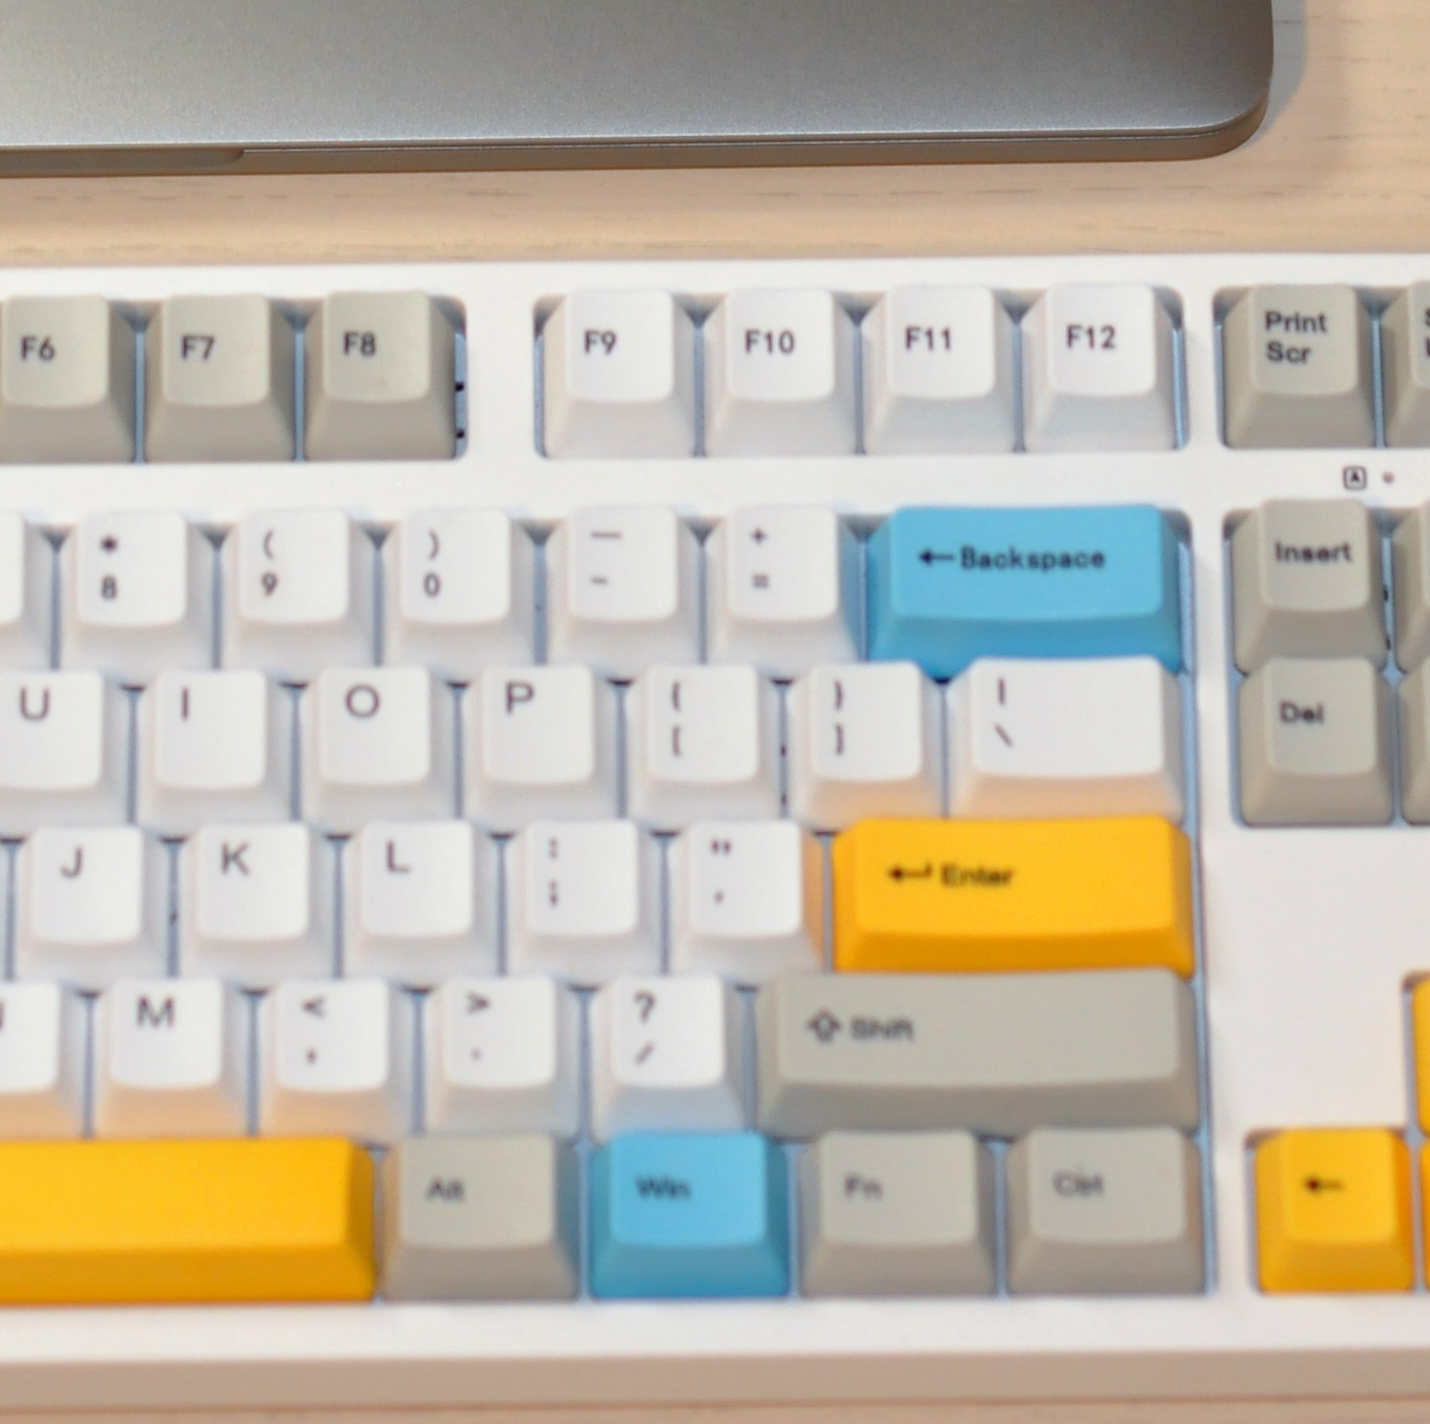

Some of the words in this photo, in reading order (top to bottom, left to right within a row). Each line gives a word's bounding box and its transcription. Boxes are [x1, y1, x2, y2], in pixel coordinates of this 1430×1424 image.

[1263, 309, 1327, 333] Print
[20, 335, 56, 362] F6
[180, 333, 216, 360] F7
[342, 330, 377, 357] F8
[583, 329, 618, 355] F9
[743, 328, 796, 355] F10
[904, 325, 951, 351] F11
[1065, 323, 1116, 351] F12
[1265, 339, 1311, 364] Scr
[959, 545, 1106, 573] Backspace
[1274, 541, 1351, 564] Insert
[100, 575, 118, 601] 8
[260, 571, 279, 597] 9
[422, 571, 442, 599] 0
[18, 687, 51, 723] U
[343, 683, 381, 720] O
[504, 680, 535, 715] P
[1279, 701, 1324, 725] Del
[60, 846, 84, 880] J
[220, 843, 249, 875] K
[385, 840, 409, 874] L
[939, 863, 1014, 888] Enter
[136, 995, 175, 1028] M
[633, 990, 657, 1023] ?
[849, 1016, 915, 1041] Shift
[426, 1178, 465, 1201] Alt
[635, 1176, 691, 1200] Win
[843, 1174, 883, 1198] Fn
[1052, 1171, 1104, 1198] Ctrl
